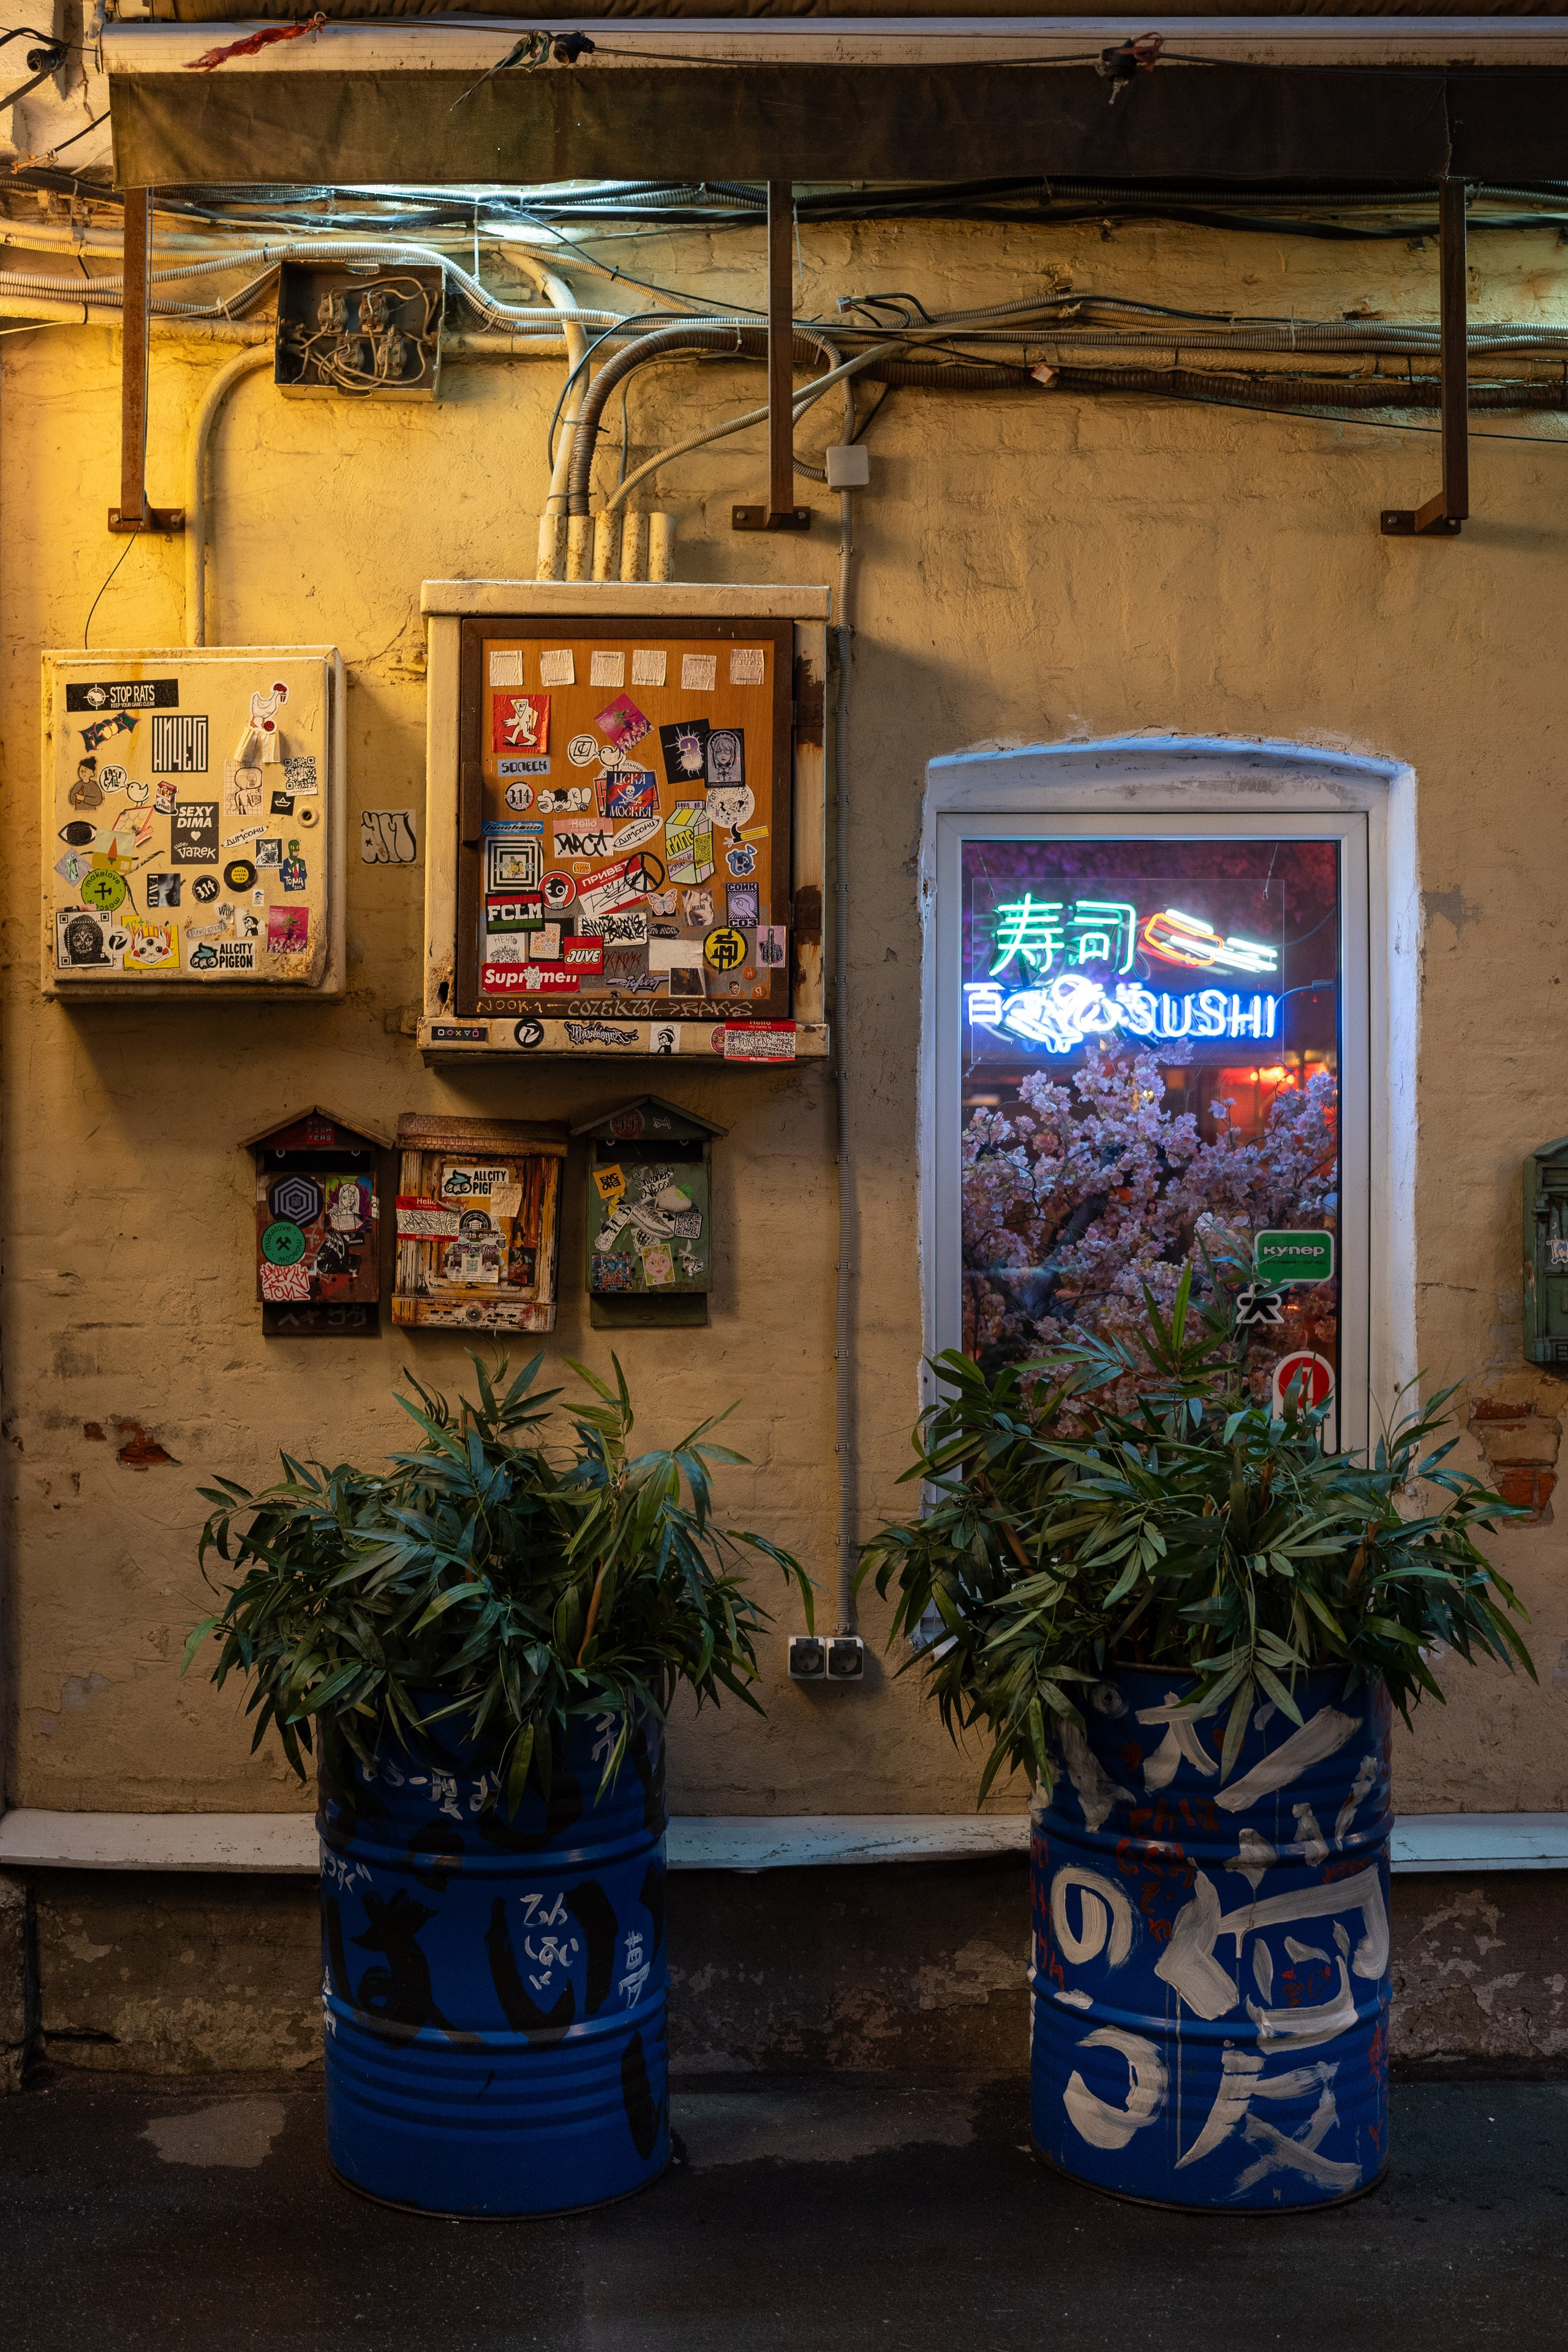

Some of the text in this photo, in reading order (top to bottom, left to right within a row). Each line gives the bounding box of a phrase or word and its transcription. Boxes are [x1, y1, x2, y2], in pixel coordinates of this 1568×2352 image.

[110, 685, 155, 703] STOP RATS
[614, 773, 646, 786] ЦСКА
[178, 805, 214, 816] SEXY
[609, 805, 651, 818] МОСКВА
[176, 817, 212, 828] DIMA
[173, 842, 188, 851] super
[85, 869, 121, 888] makelove
[581, 860, 629, 887] ПРИВЕТ
[195, 880, 214, 899] 3,14
[487, 903, 543, 921] FCLM
[989, 893, 1136, 976] 寿司
[219, 955, 253, 968] PIGEON
[566, 949, 601, 963] JUVE
[1128, 990, 1275, 1038] SUSHI
[265, 1224, 292, 1251] makelove
[278, 1239, 302, 1262] moscow
[1263, 1245, 1325, 1257] купер
